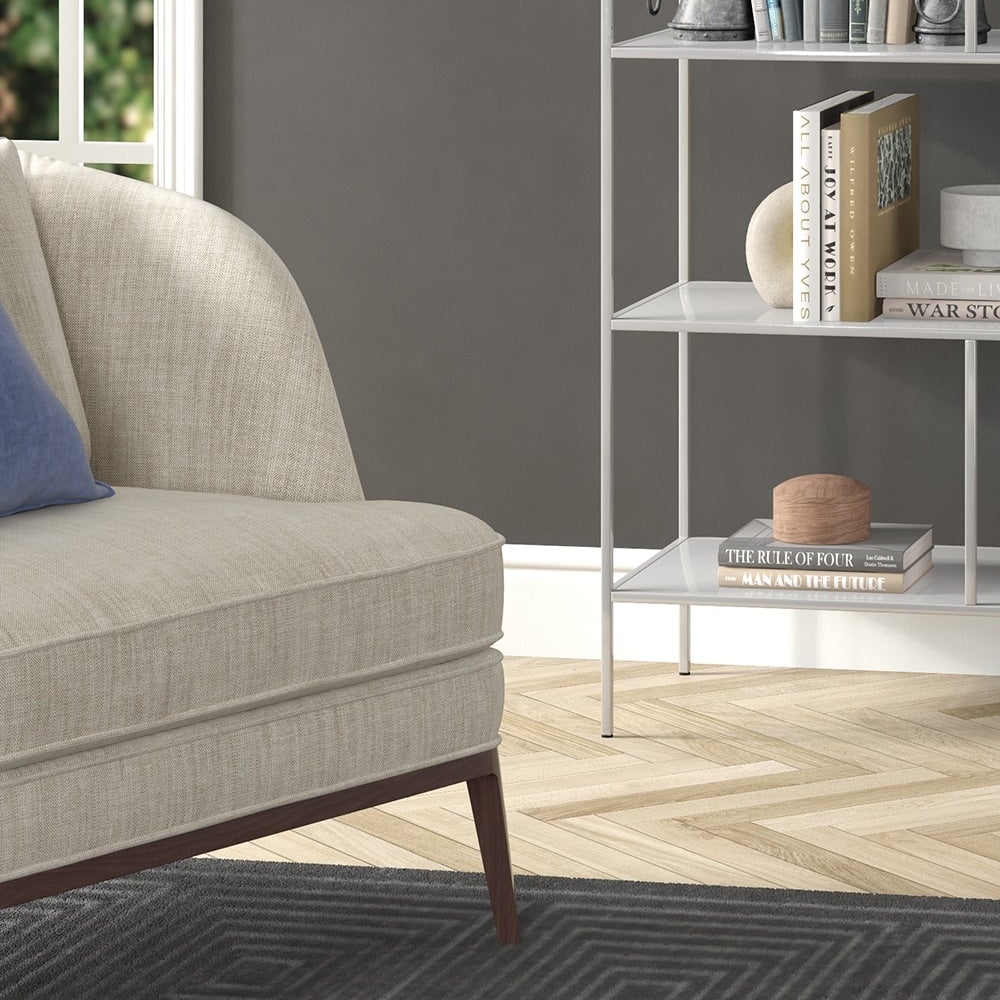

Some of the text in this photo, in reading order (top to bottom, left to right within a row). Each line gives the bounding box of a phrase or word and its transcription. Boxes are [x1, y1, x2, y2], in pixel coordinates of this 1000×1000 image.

[824, 165, 837, 201] JOY
[800, 115, 810, 319] ALL ABOUT YVES
[824, 209, 837, 232] AT
[824, 241, 837, 296] WORK
[906, 280, 960, 296] MADE
[906, 303, 963, 318] WAR
[725, 548, 854, 567] THE RULE OF FOUR
[741, 572, 886, 591] MAN AND THE FUTURE
